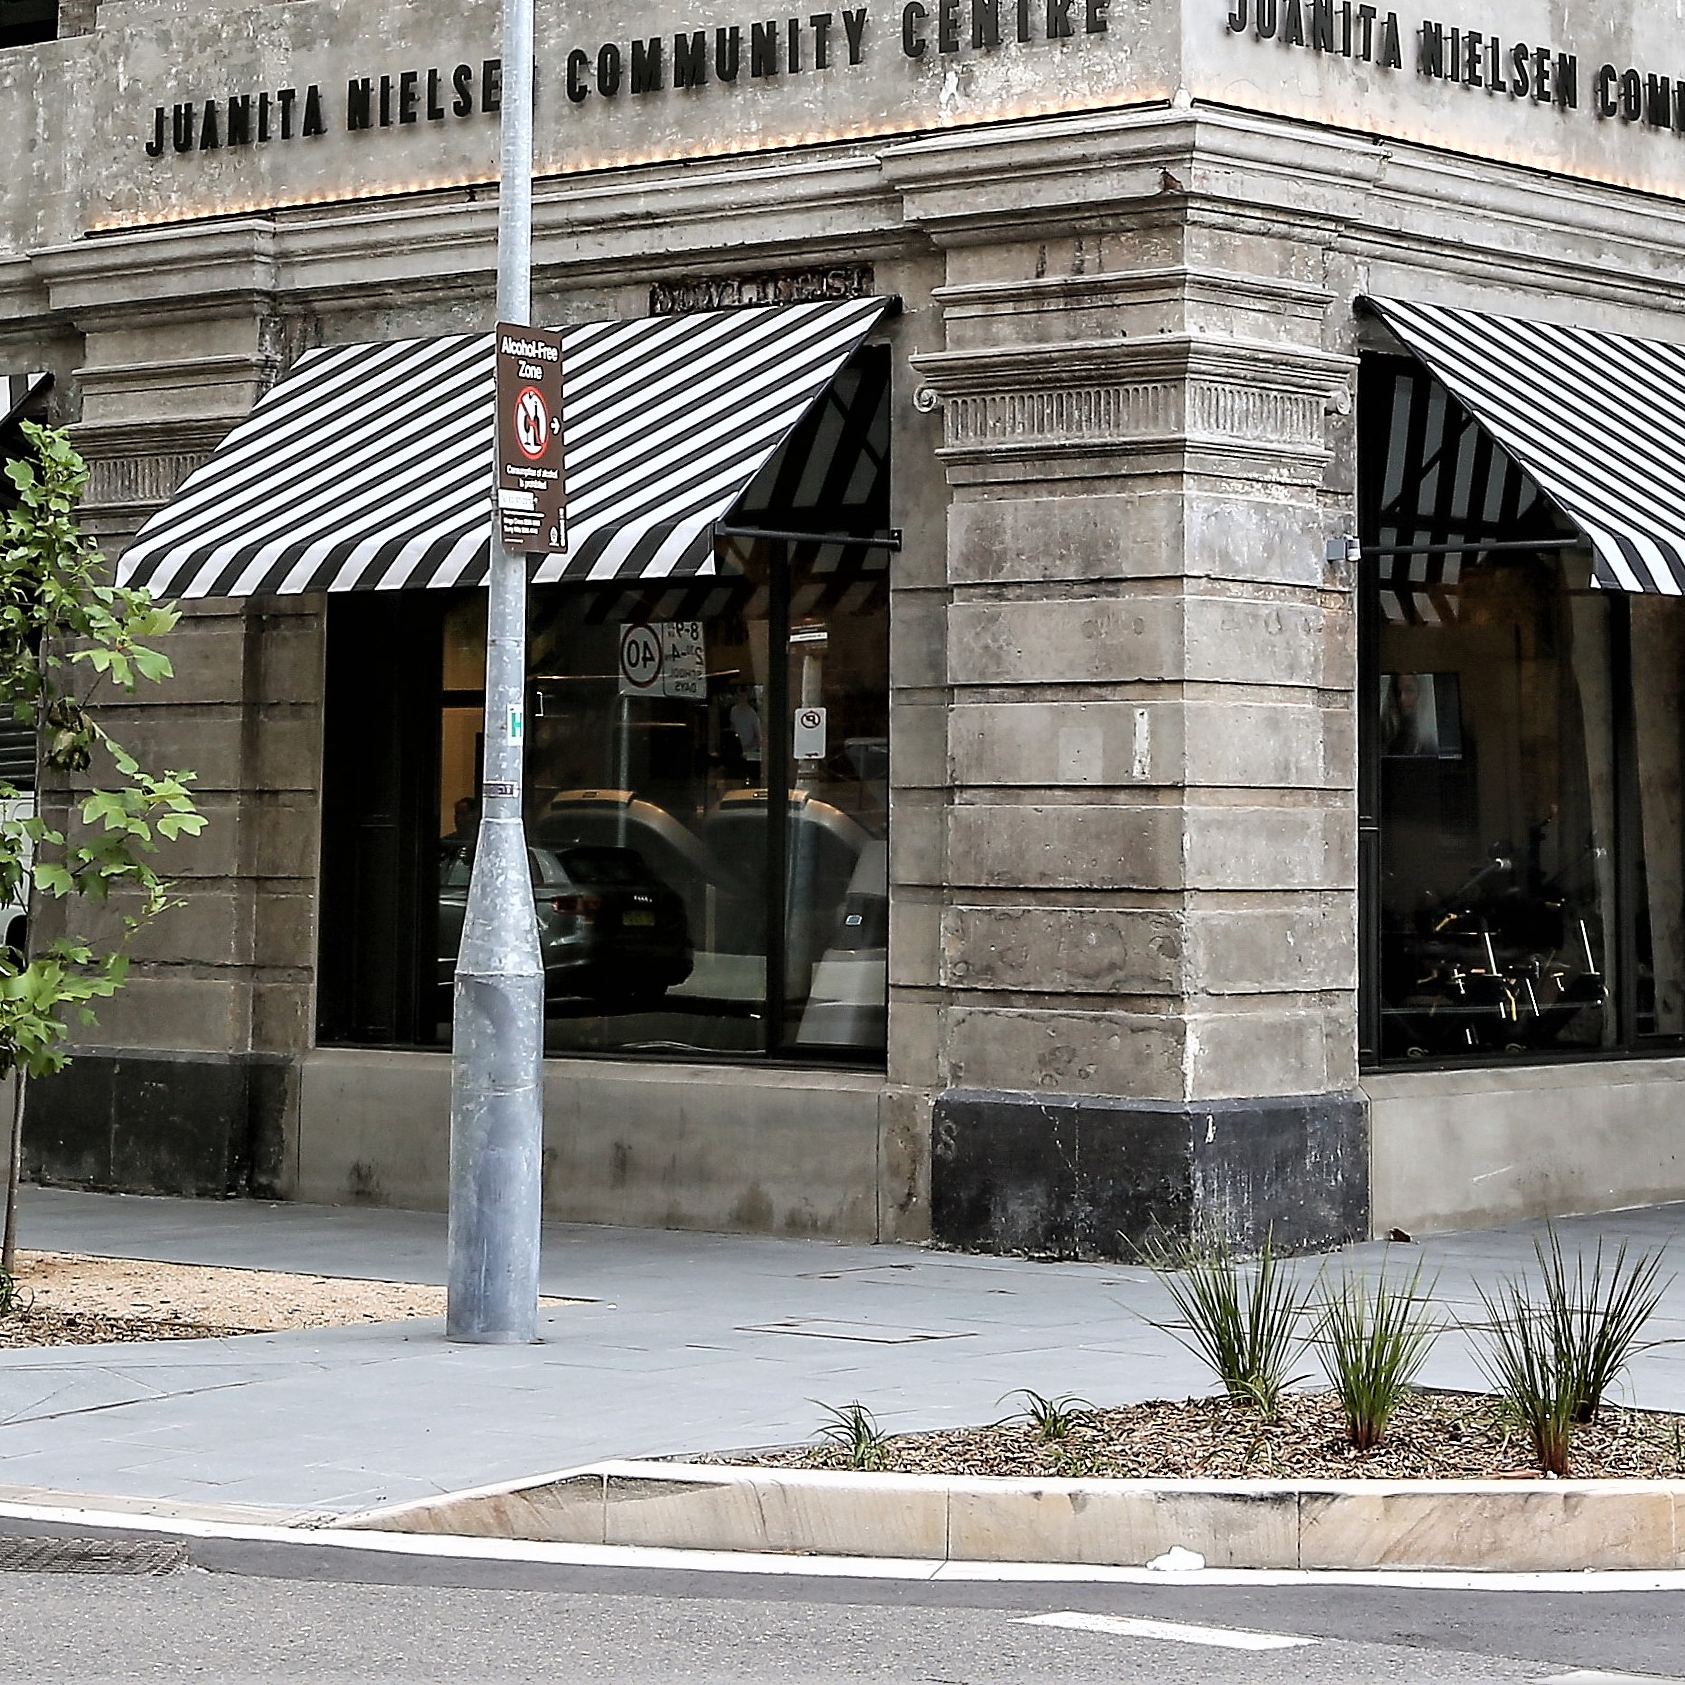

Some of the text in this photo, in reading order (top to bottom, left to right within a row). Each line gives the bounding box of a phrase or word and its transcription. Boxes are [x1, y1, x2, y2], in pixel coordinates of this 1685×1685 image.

[145, 84, 324, 158] JUANITA
[347, 59, 534, 132] NIELSE
[565, 8, 868, 103] COMMUNITY
[1421, 20, 1578, 109] NIELSEN
[500, 336, 558, 362] Alcohol-Free
[518, 360, 543, 380] Zone
